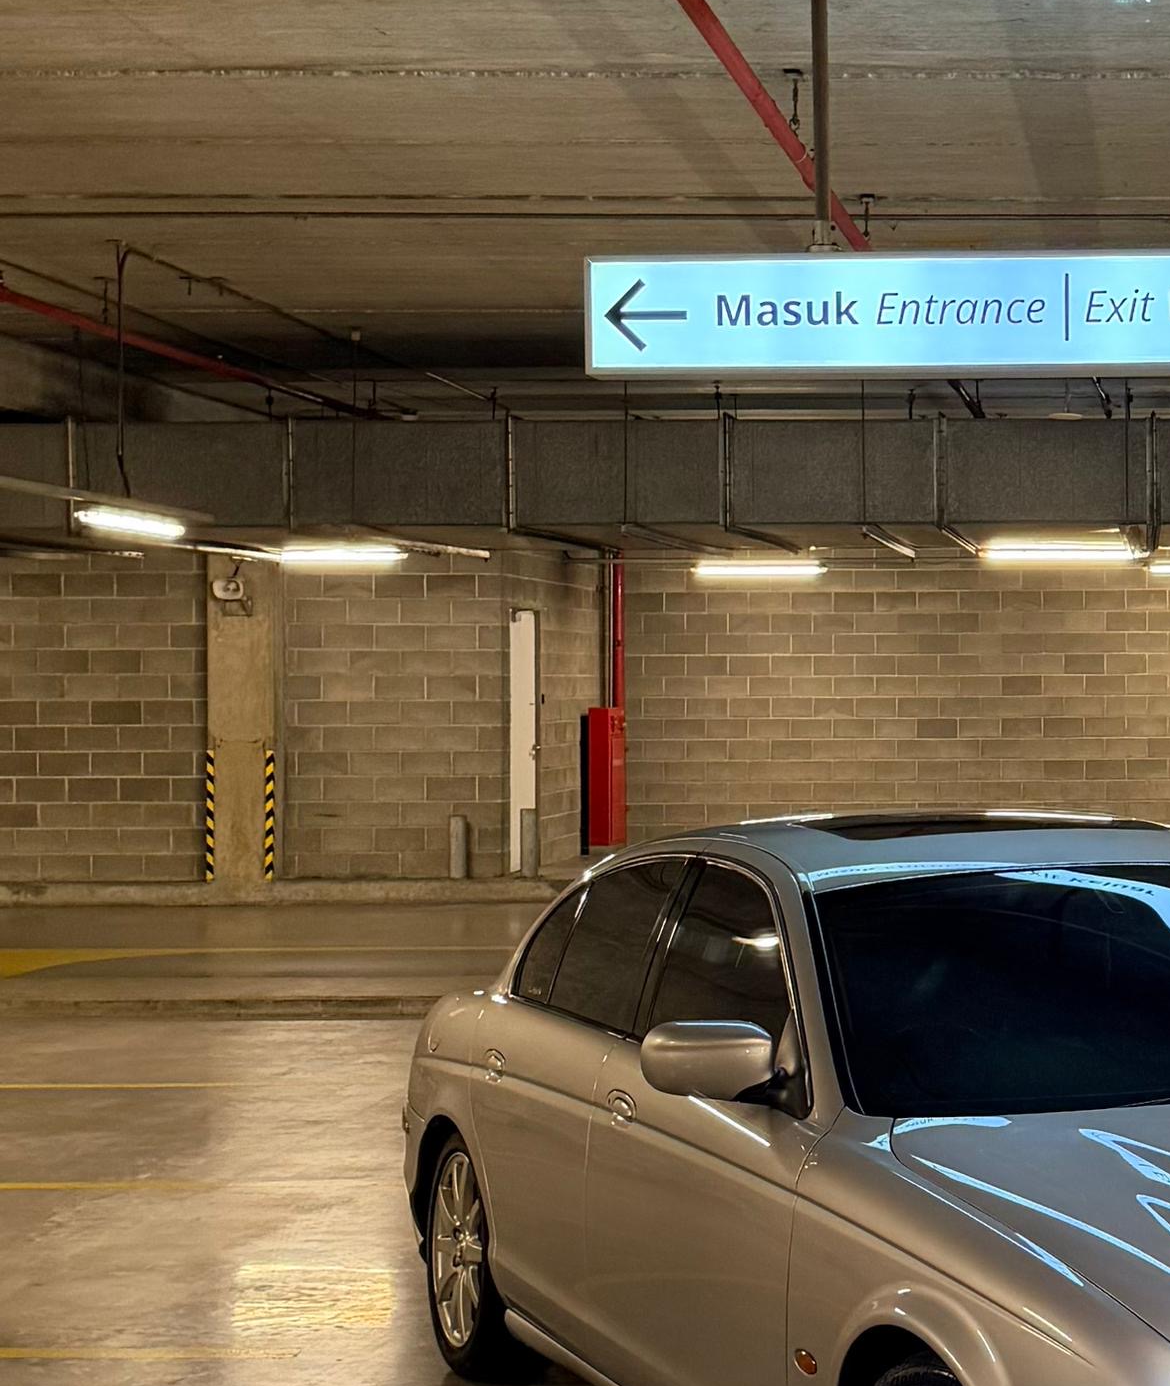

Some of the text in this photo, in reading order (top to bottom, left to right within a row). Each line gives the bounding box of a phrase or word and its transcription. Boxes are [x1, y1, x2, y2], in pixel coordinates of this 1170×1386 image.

[716, 291, 860, 327] Masuk
[876, 292, 1046, 326] Entrance
[1085, 288, 1155, 323] Exit
